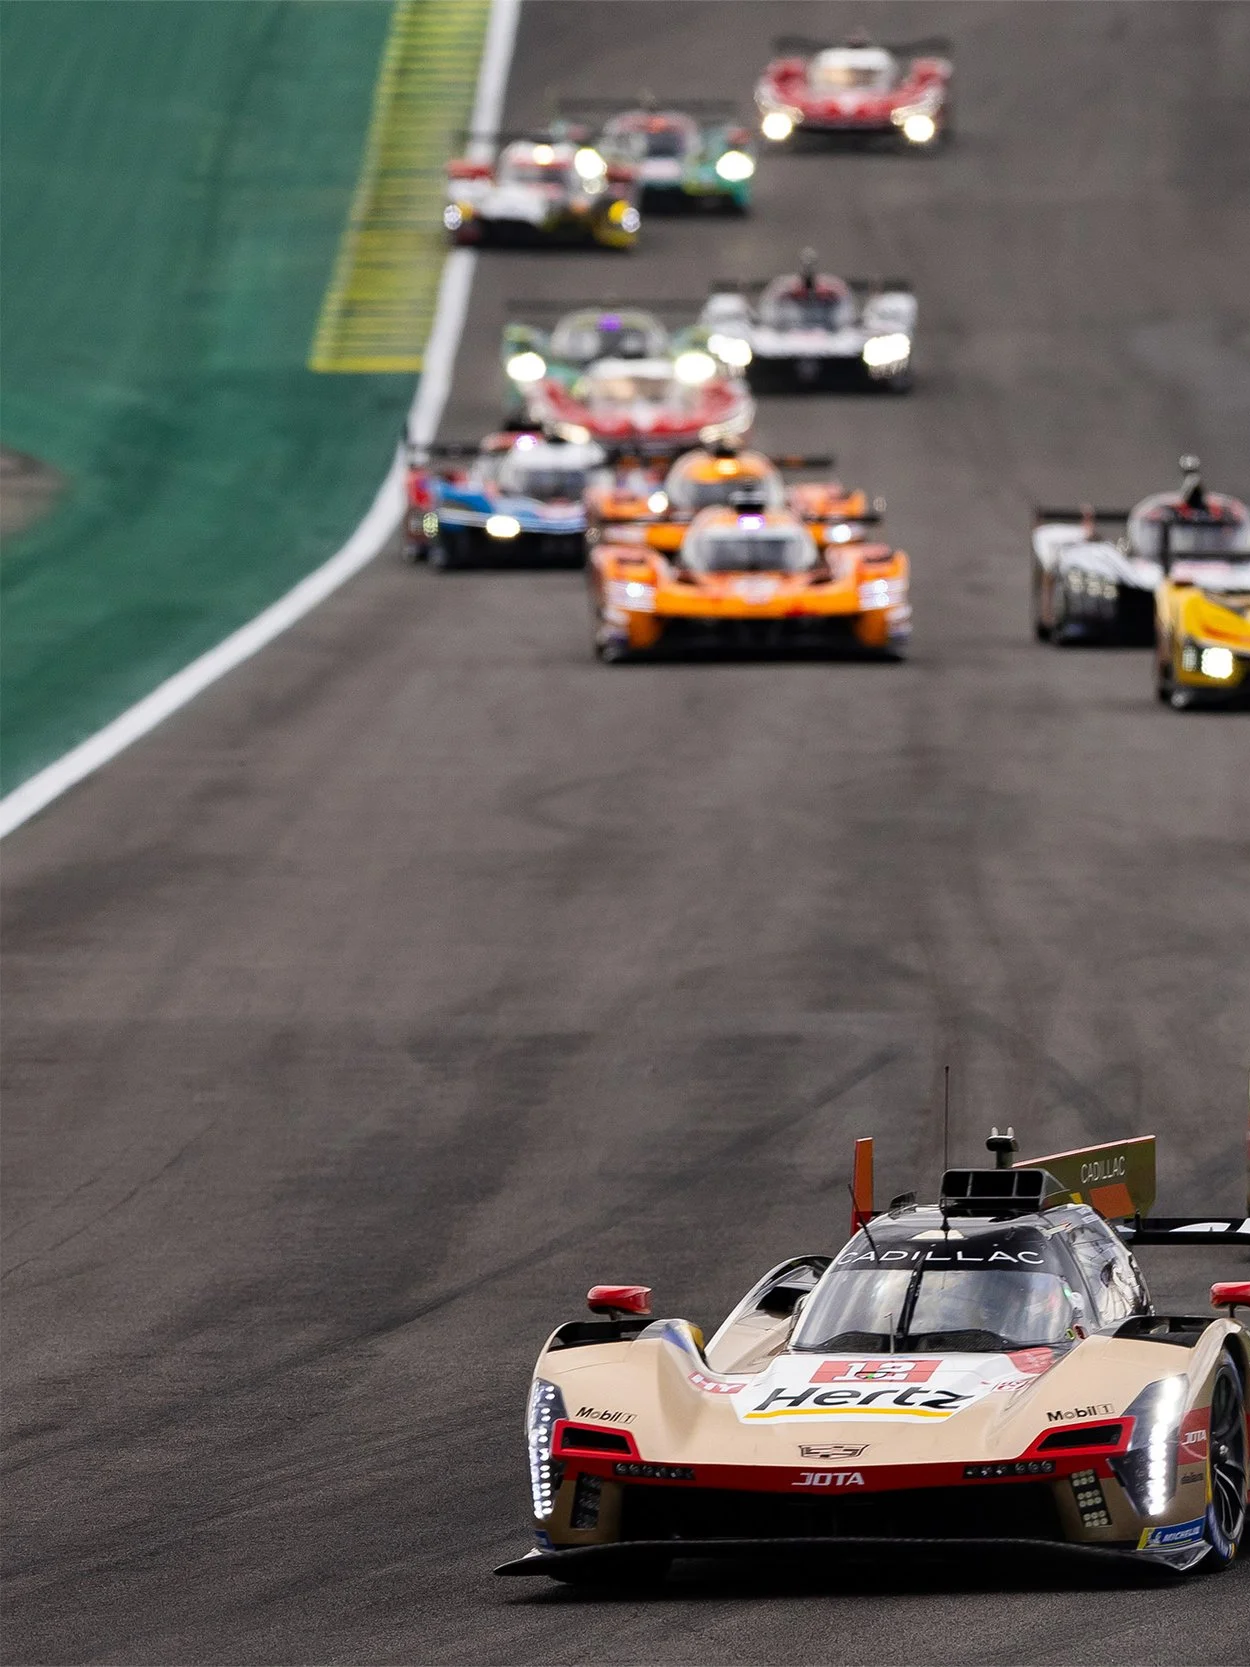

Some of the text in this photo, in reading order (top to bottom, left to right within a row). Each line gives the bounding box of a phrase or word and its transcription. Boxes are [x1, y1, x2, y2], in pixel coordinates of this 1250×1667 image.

[1081, 1155, 1126, 1184] CADILLAC
[837, 1250, 1044, 1265] CADILLAC
[752, 1386, 975, 1411] Hertz
[575, 1406, 622, 1422] Mobil
[1046, 1406, 1097, 1422] Mobil
[1181, 1429, 1207, 1446] JOTA
[791, 1472, 865, 1486] JOTA
